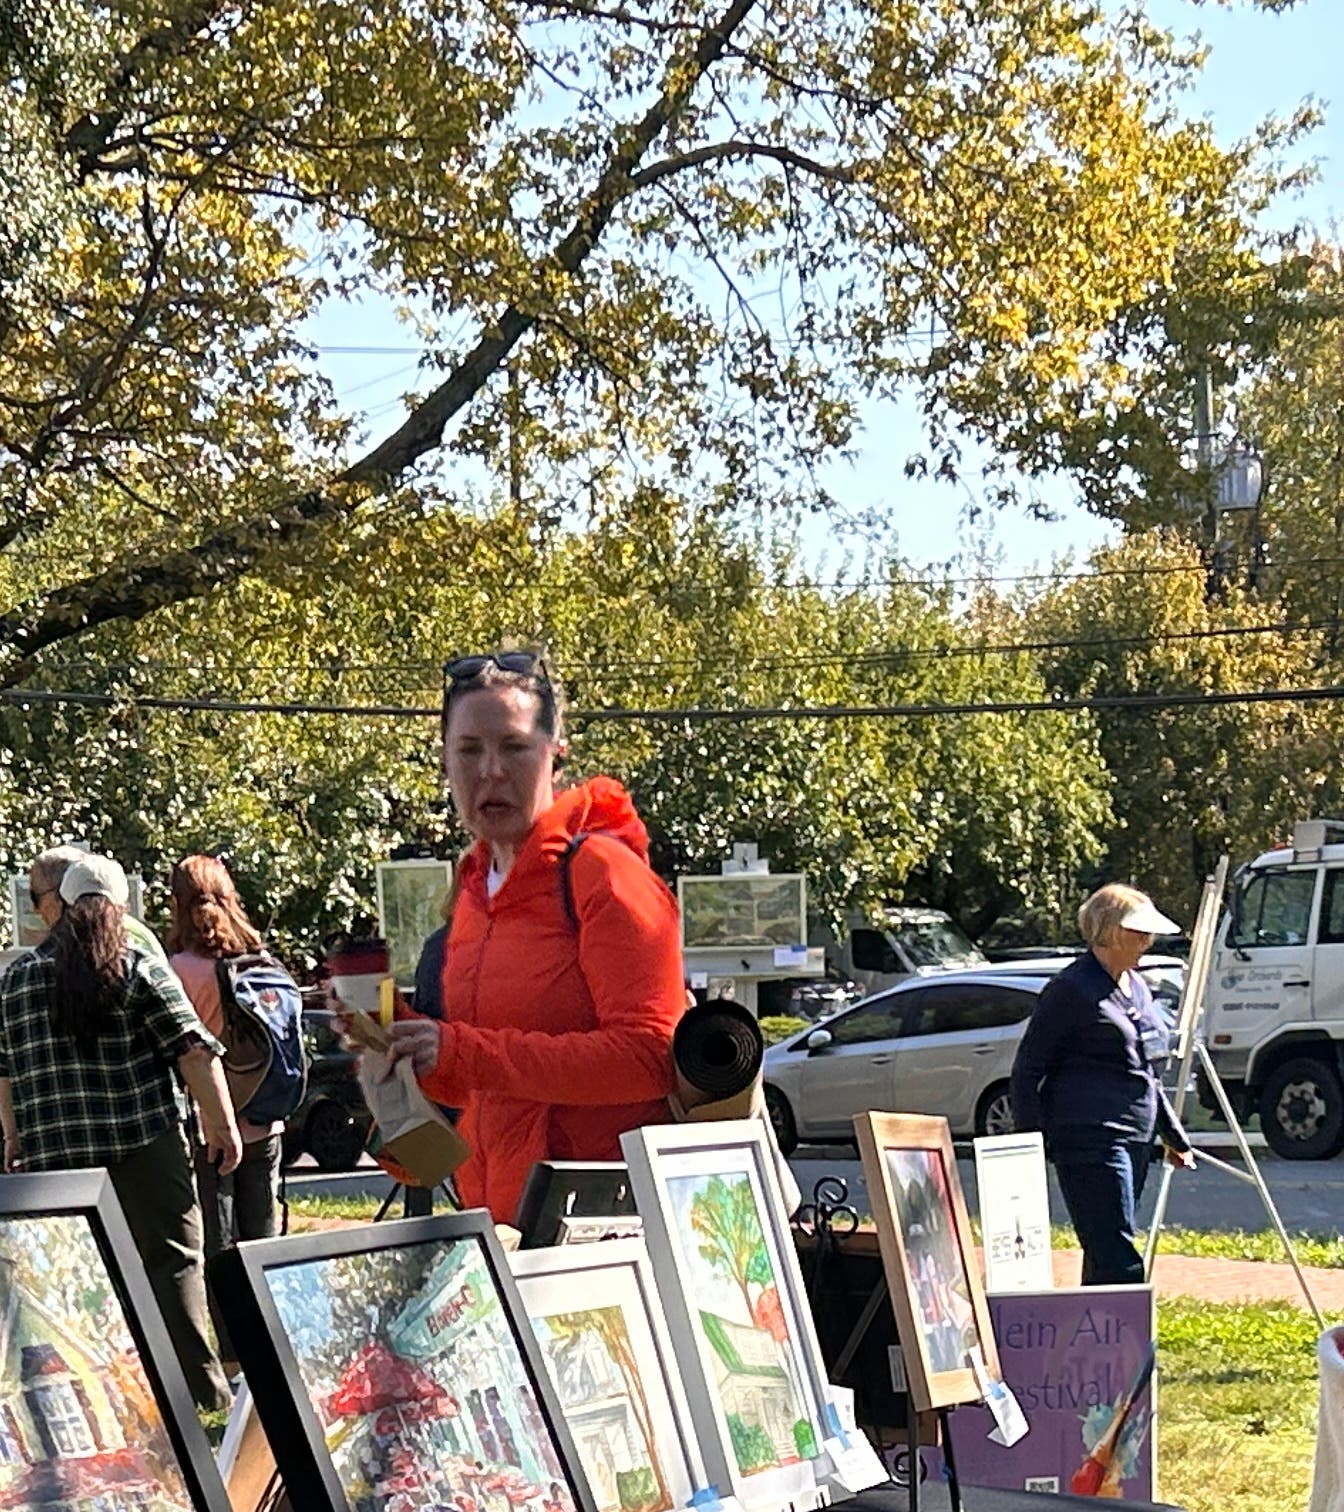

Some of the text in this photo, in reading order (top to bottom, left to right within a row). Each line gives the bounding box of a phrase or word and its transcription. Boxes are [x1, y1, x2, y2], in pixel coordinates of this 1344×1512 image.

[995, 1304, 1128, 1350] lein Air
[1014, 1362, 1112, 1411] estival
